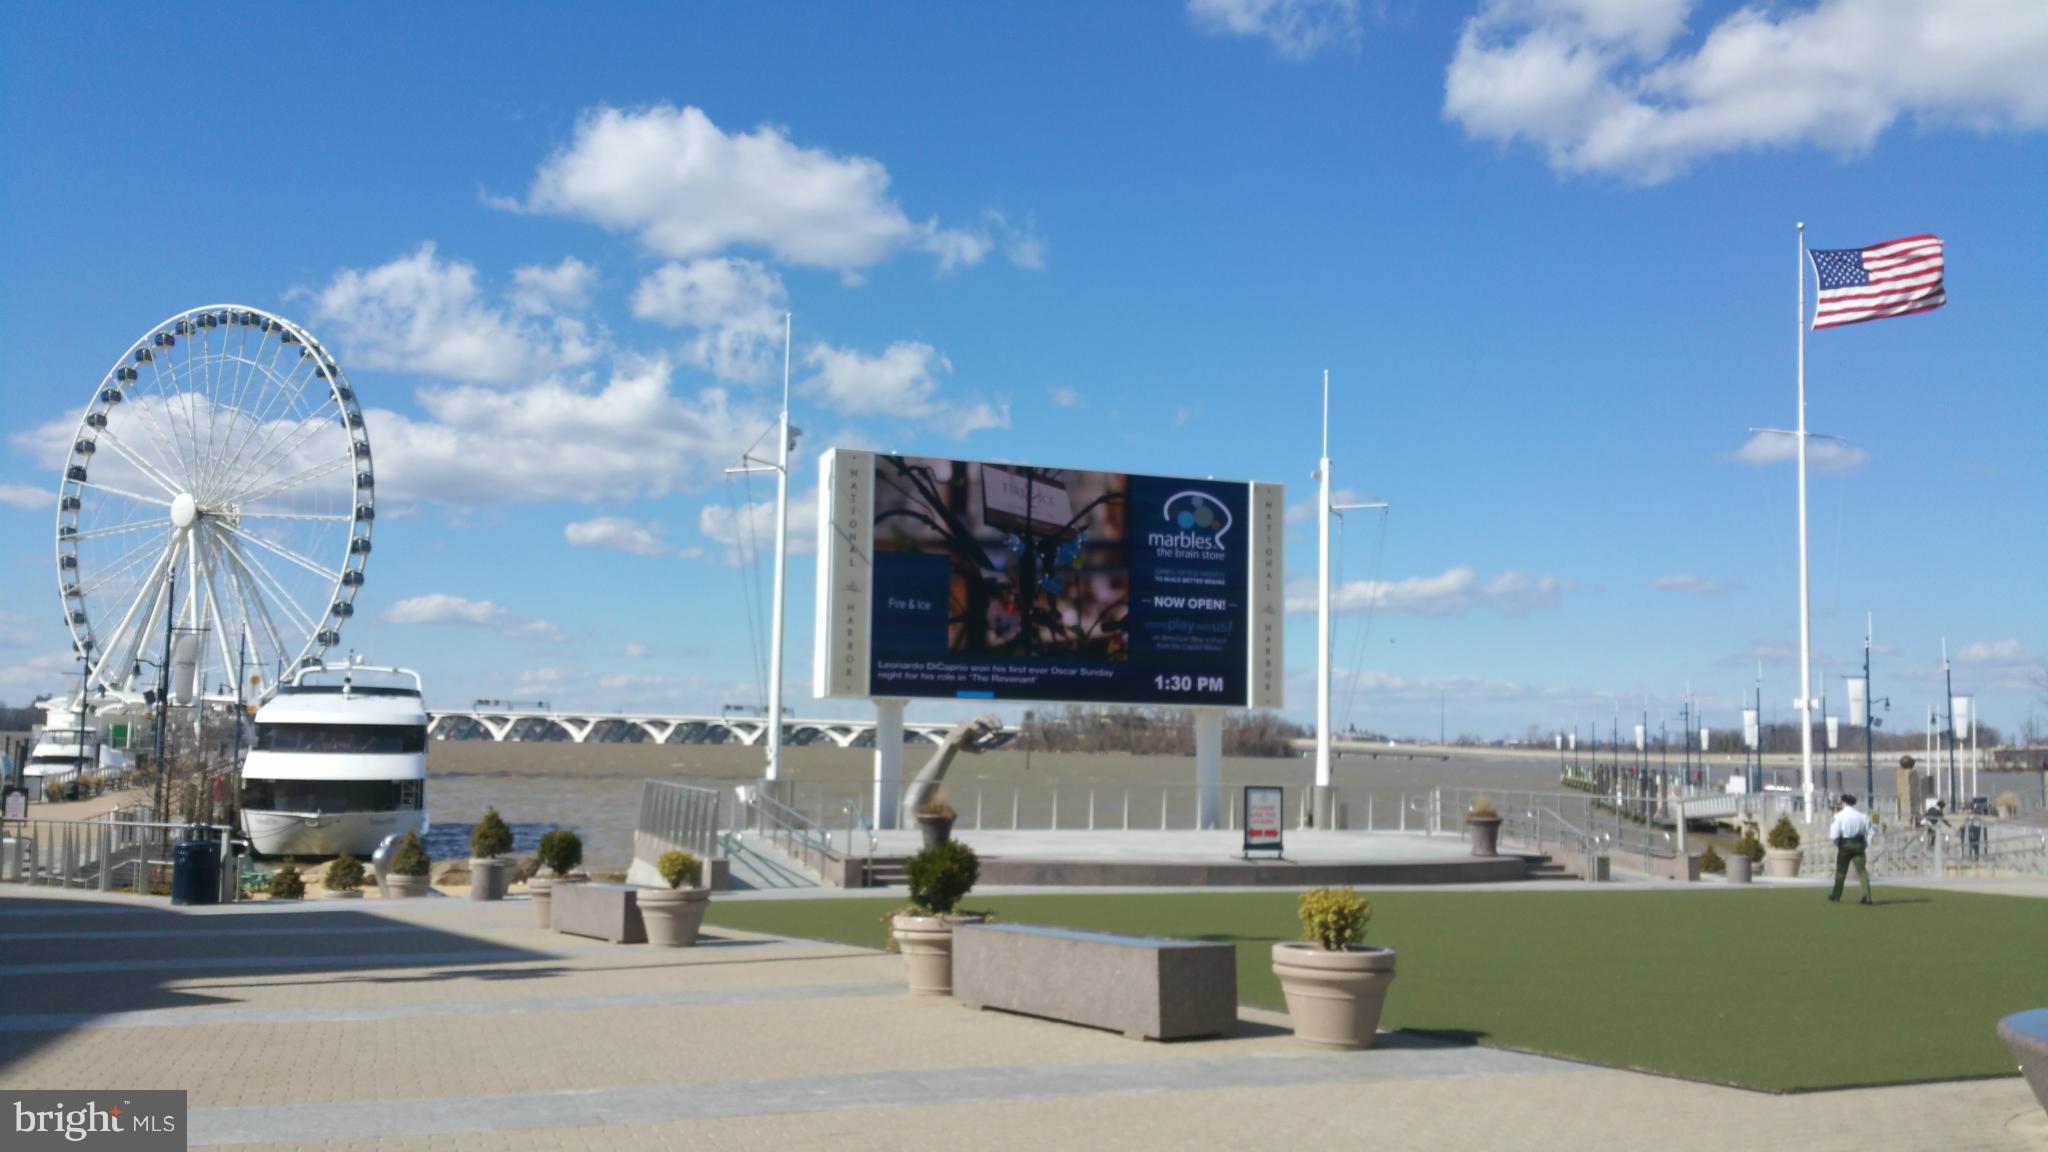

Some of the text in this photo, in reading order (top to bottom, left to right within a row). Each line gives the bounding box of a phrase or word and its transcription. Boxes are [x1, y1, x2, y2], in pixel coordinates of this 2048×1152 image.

[1148, 531, 1212, 550] marbles
[1157, 547, 1225, 561] the brain store
[845, 469, 859, 677] NATIONAL HARBOR
[1154, 596, 1226, 610] NOW OPEN!
[1264, 501, 1273, 692] NATIONAL HARBOR
[878, 661, 1113, 678] Leonardo DiCaprio won his first ever Oscar Sunday
[878, 671, 902, 681] night
[904, 672, 918, 680] for
[920, 672, 935, 680] his
[937, 673, 956, 681] role
[1155, 675, 1224, 692] 1:30 PM
